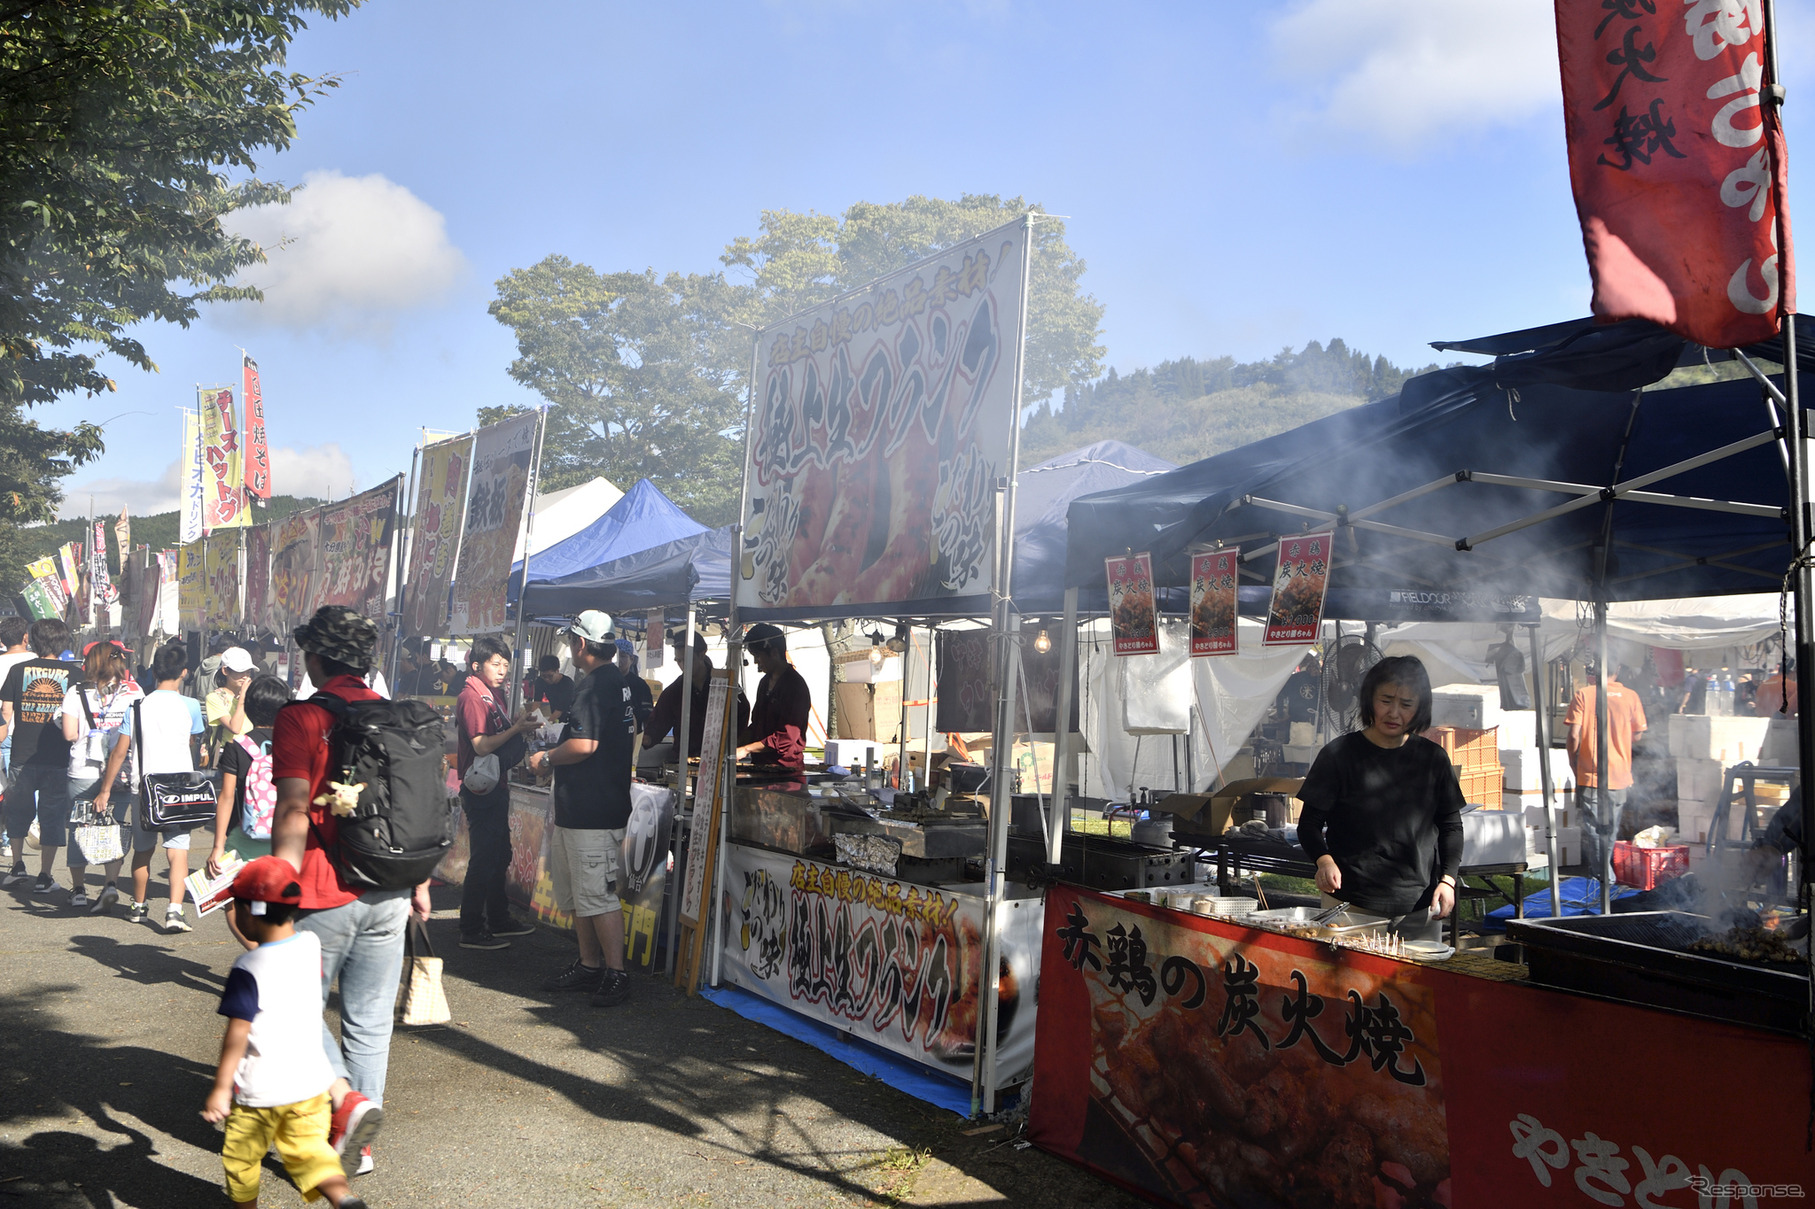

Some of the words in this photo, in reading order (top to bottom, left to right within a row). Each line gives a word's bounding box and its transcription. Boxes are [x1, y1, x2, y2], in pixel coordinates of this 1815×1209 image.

[768, 240, 1014, 368] 店主自慢の絶品素材!
[753, 287, 1002, 487] 極上生フランク
[468, 479, 507, 531] 鉄板
[1112, 578, 1151, 596] 炭火焼
[1194, 573, 1234, 593] 炭火焼
[1279, 558, 1327, 579] 炭火焼
[180, 793, 214, 803] IMPUL
[789, 859, 959, 928] 店主自慢の絶品素材!
[787, 889, 954, 1053] 極上生フランク
[1055, 901, 1428, 1088] 赤鶏の炭火焼
